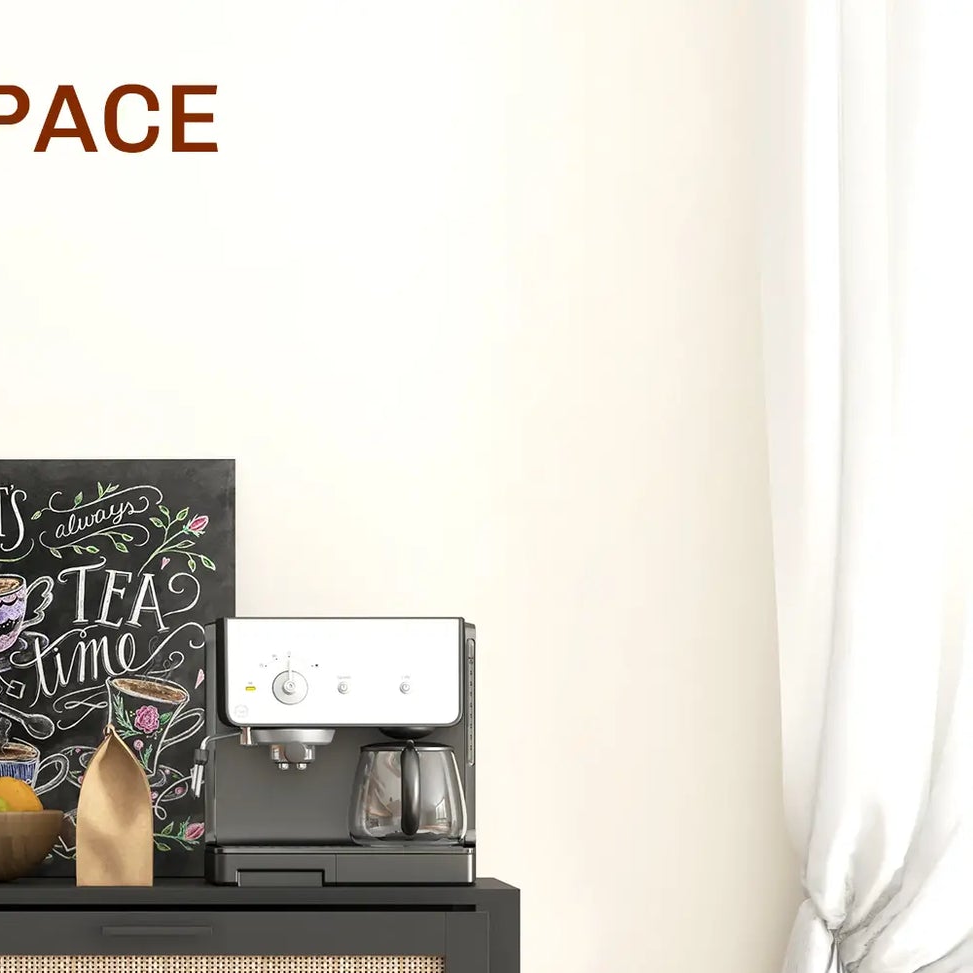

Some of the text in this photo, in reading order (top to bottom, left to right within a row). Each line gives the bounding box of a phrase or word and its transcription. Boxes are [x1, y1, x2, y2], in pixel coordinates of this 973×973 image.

[55, 496, 149, 539] always
[57, 556, 170, 633] TEA
[10, 630, 137, 707] time
